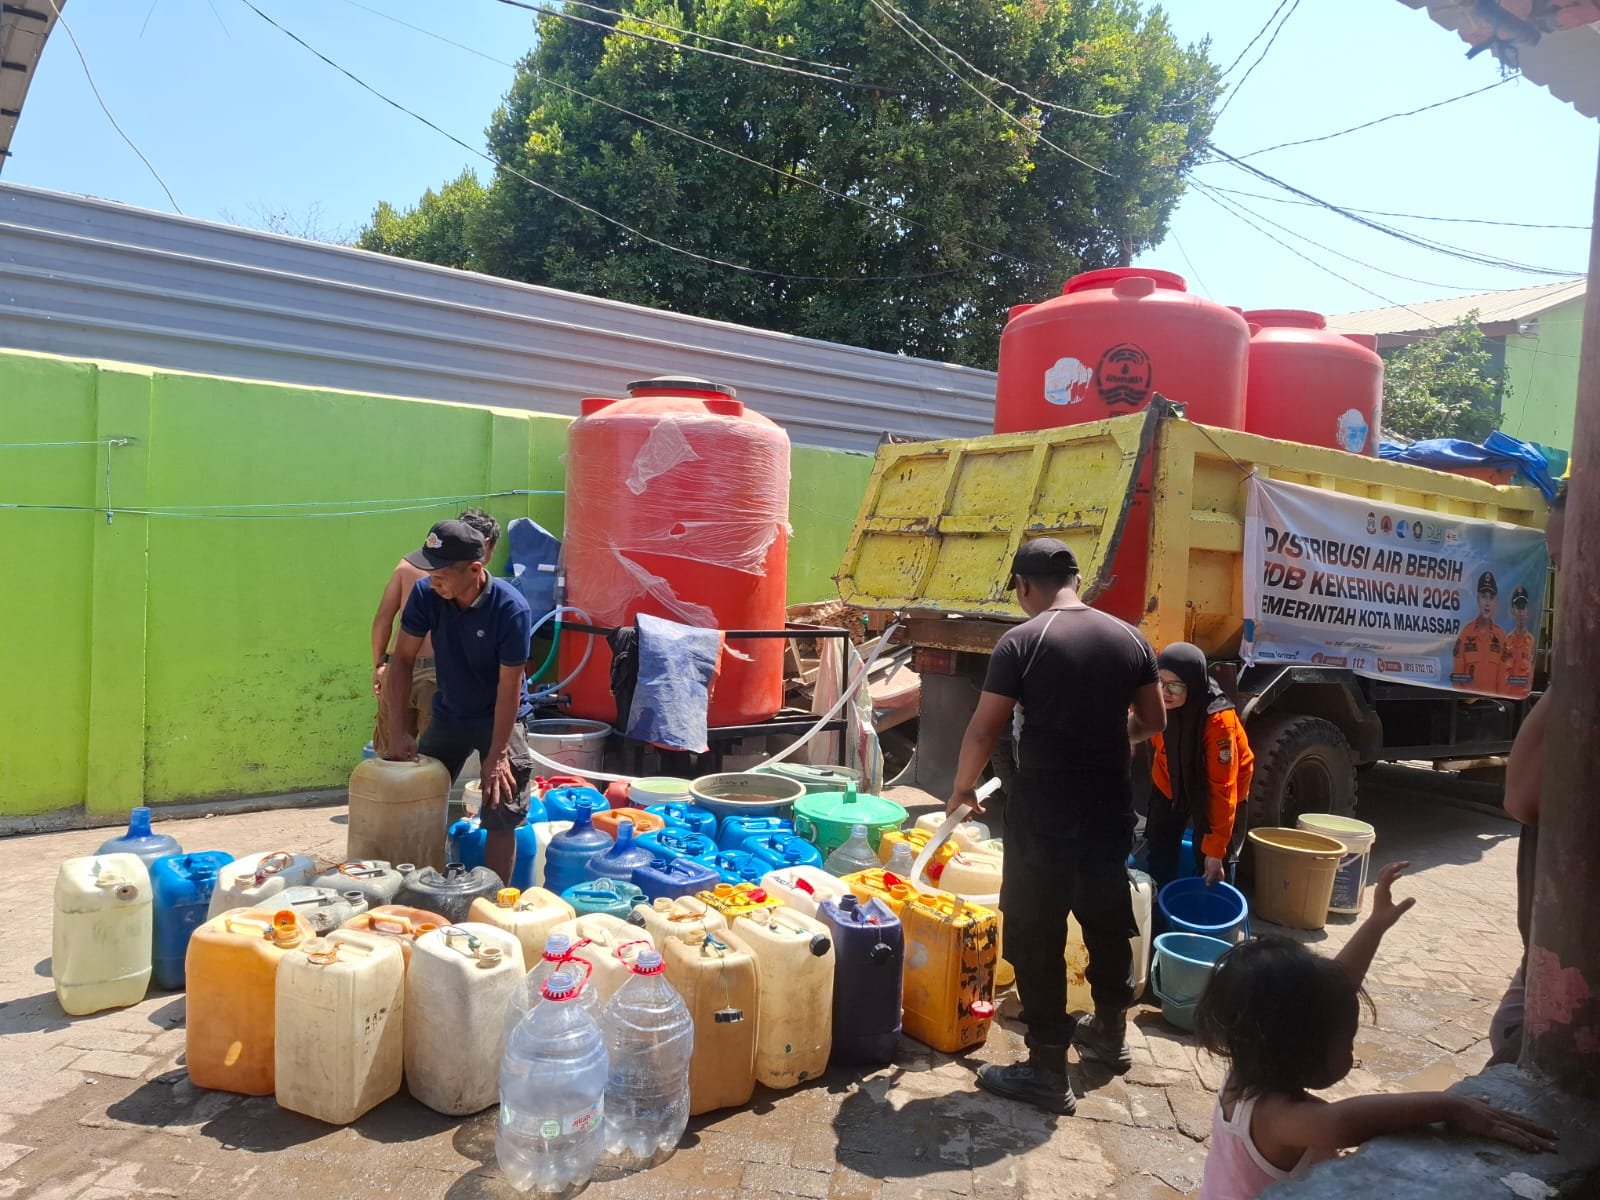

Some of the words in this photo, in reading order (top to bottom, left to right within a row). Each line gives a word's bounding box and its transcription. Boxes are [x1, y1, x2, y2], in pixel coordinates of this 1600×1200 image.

[1264, 527, 1370, 570] DISTRIBUSI
[1372, 549, 1403, 575] AIR
[1405, 553, 1463, 582] BERSIH
[1309, 571, 1419, 607] KEKERINGAN
[1422, 587, 1460, 611] 2026
[1262, 595, 1356, 626] EMERINTAH
[1358, 609, 1391, 630] KOTA
[1394, 613, 1461, 635] MAKASSAR
